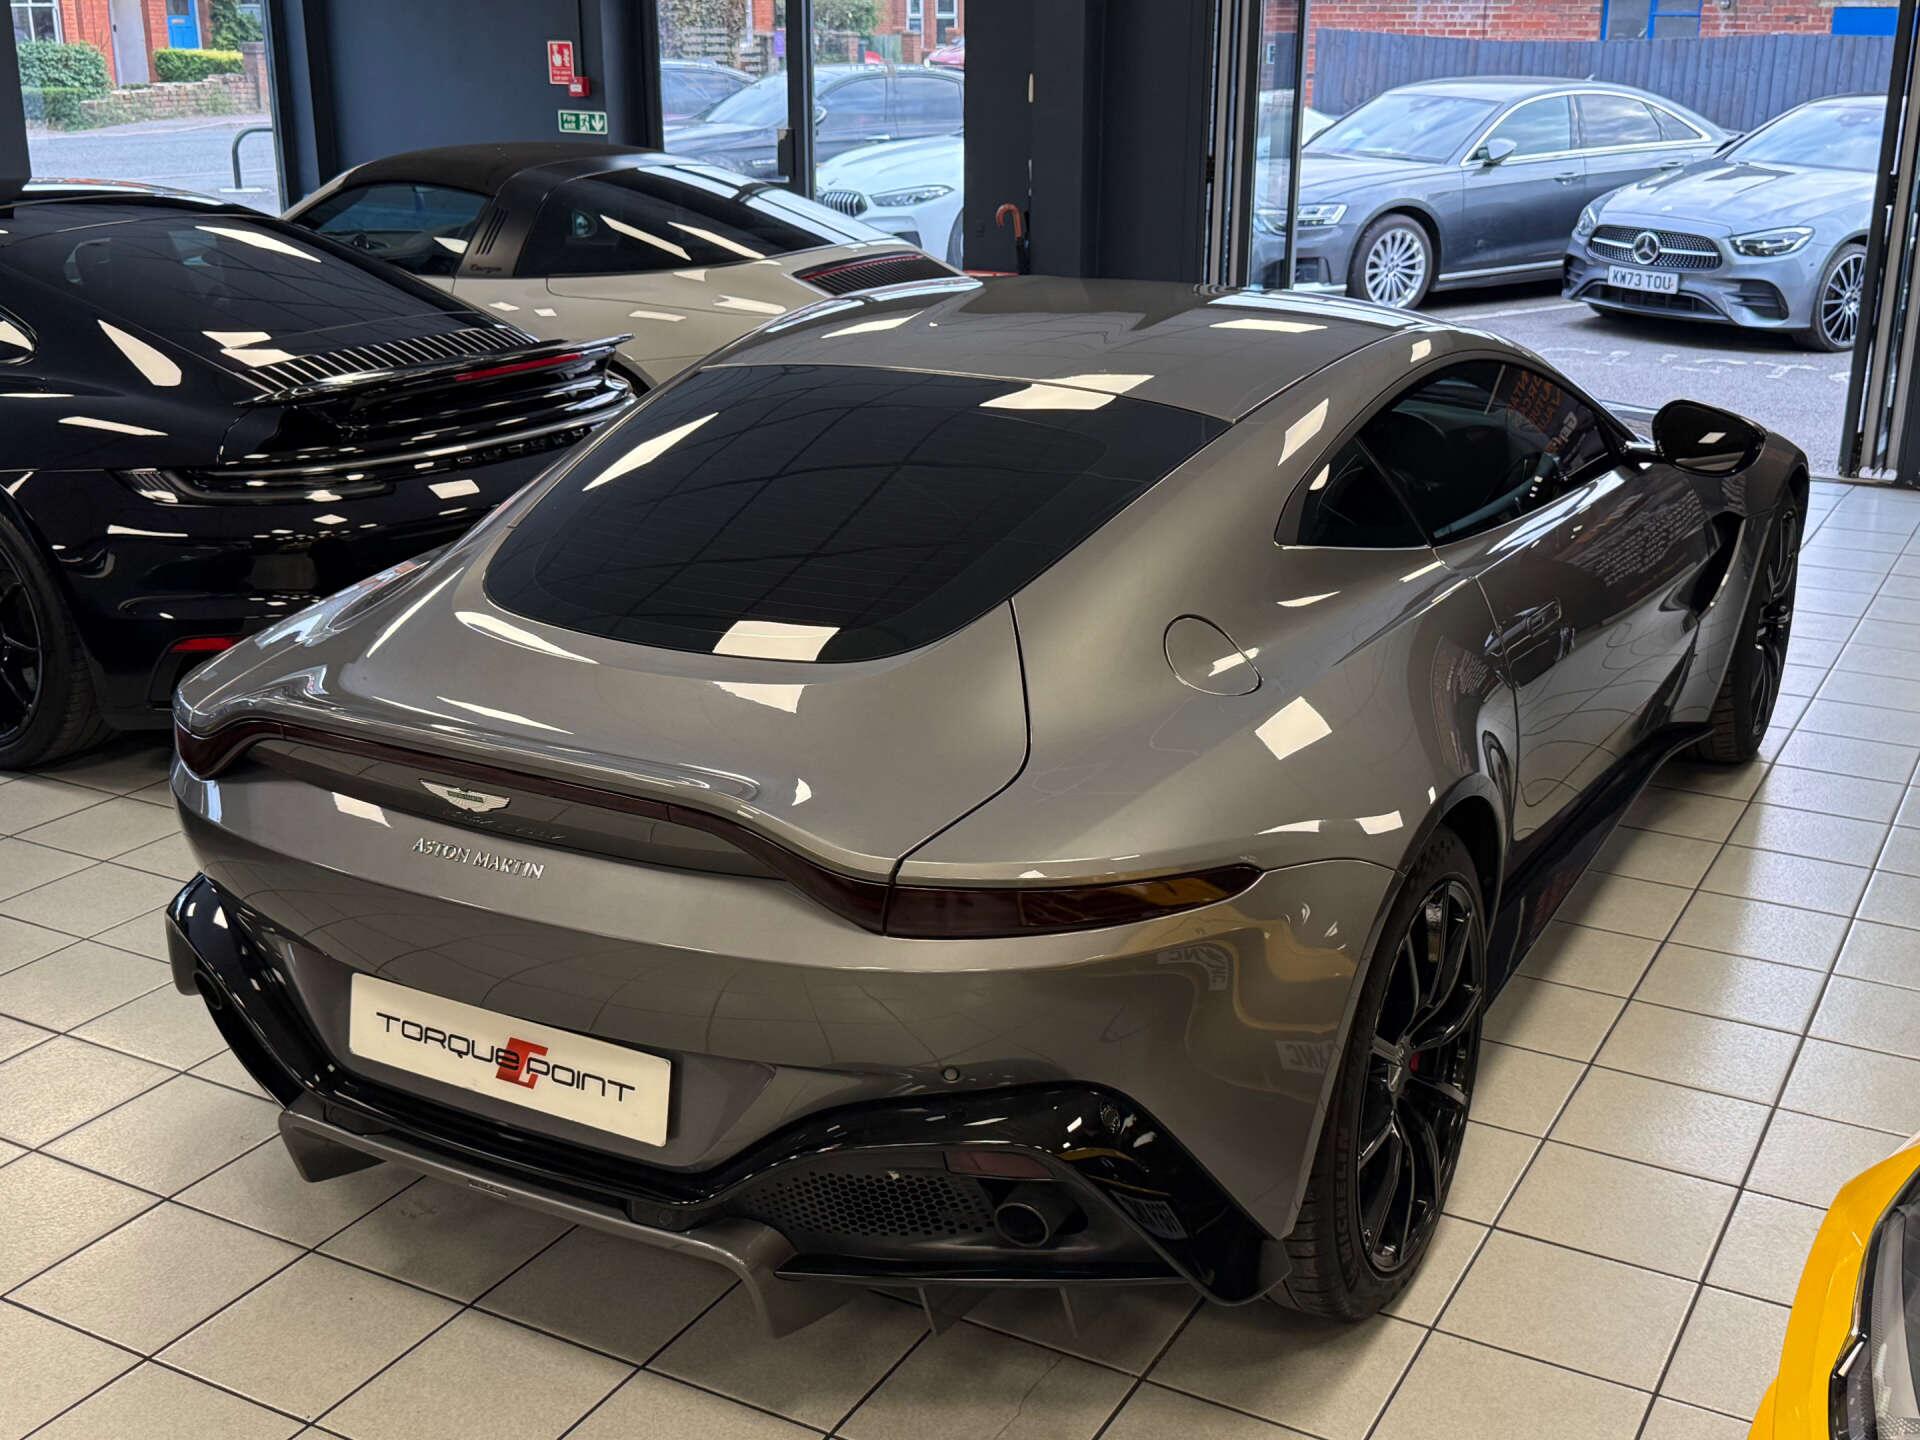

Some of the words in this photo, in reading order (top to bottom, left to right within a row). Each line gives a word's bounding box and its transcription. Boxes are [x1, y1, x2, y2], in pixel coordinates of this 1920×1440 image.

[1646, 274, 1672, 290] TOU
[412, 837, 471, 864] ASTON
[472, 851, 545, 880] MARTIN
